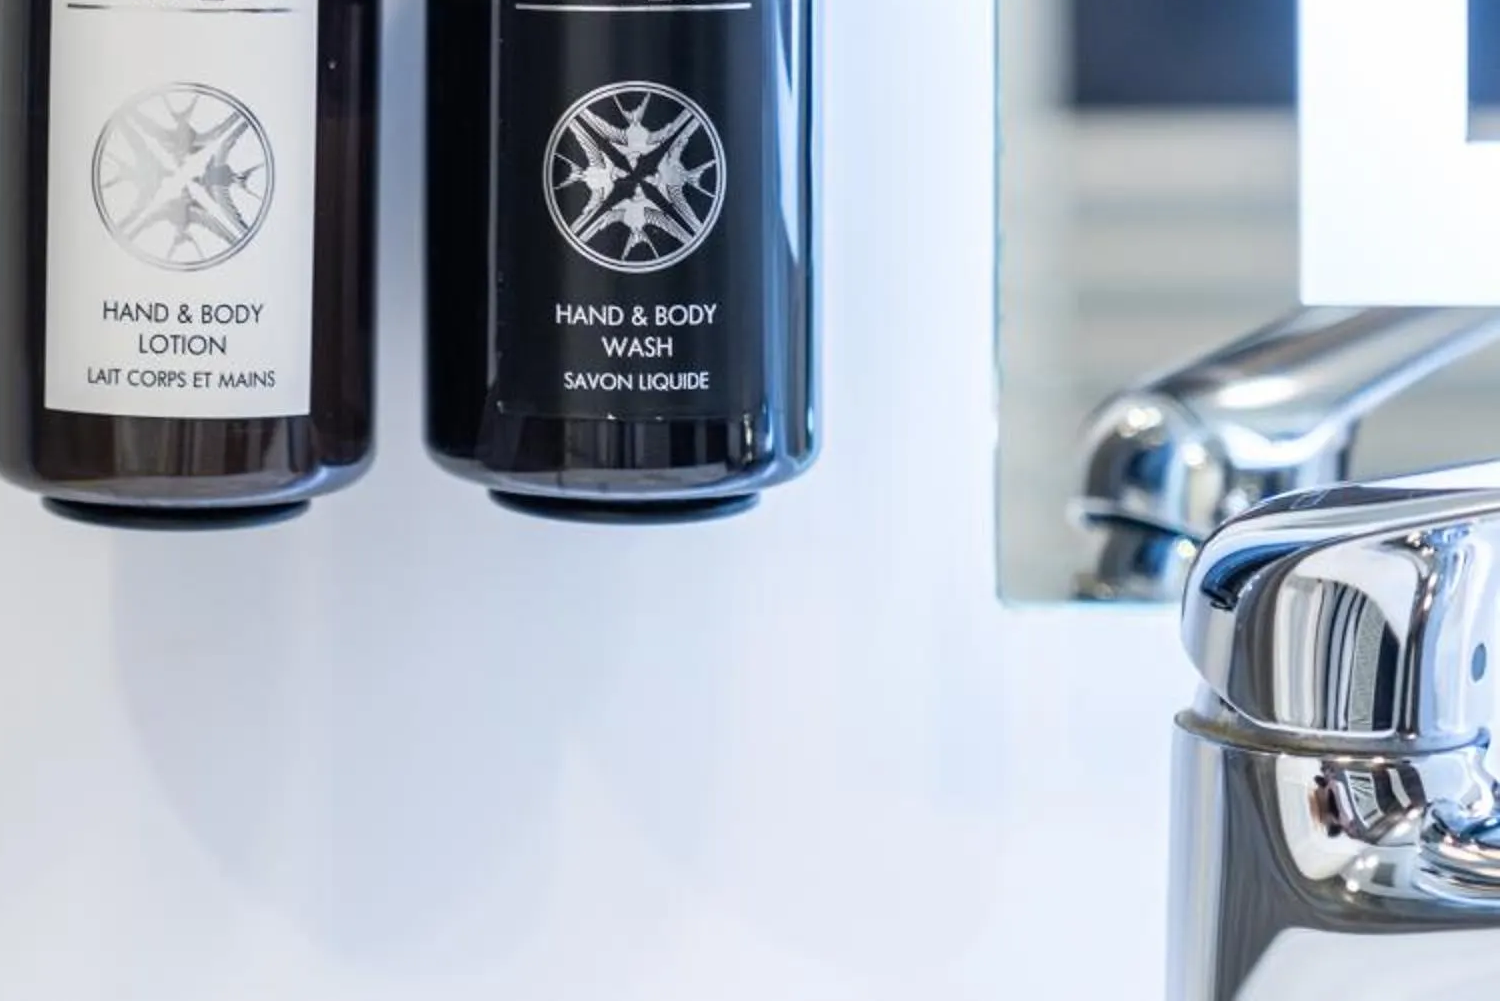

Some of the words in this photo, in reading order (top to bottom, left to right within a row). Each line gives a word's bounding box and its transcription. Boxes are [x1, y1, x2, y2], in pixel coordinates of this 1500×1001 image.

[102, 300, 170, 324] HAND
[176, 302, 194, 325] &
[200, 303, 264, 325] BODY
[555, 302, 625, 327] HAND
[630, 304, 649, 327] &
[654, 302, 717, 327] BODY
[138, 333, 228, 357] LOTION
[600, 335, 674, 358] WASH
[87, 366, 123, 386] LAIT
[126, 368, 188, 389] CORPS
[192, 370, 214, 389] ET
[217, 369, 277, 389] MAINS
[563, 370, 634, 392] SAVON
[638, 370, 710, 392] LIQUIDE
